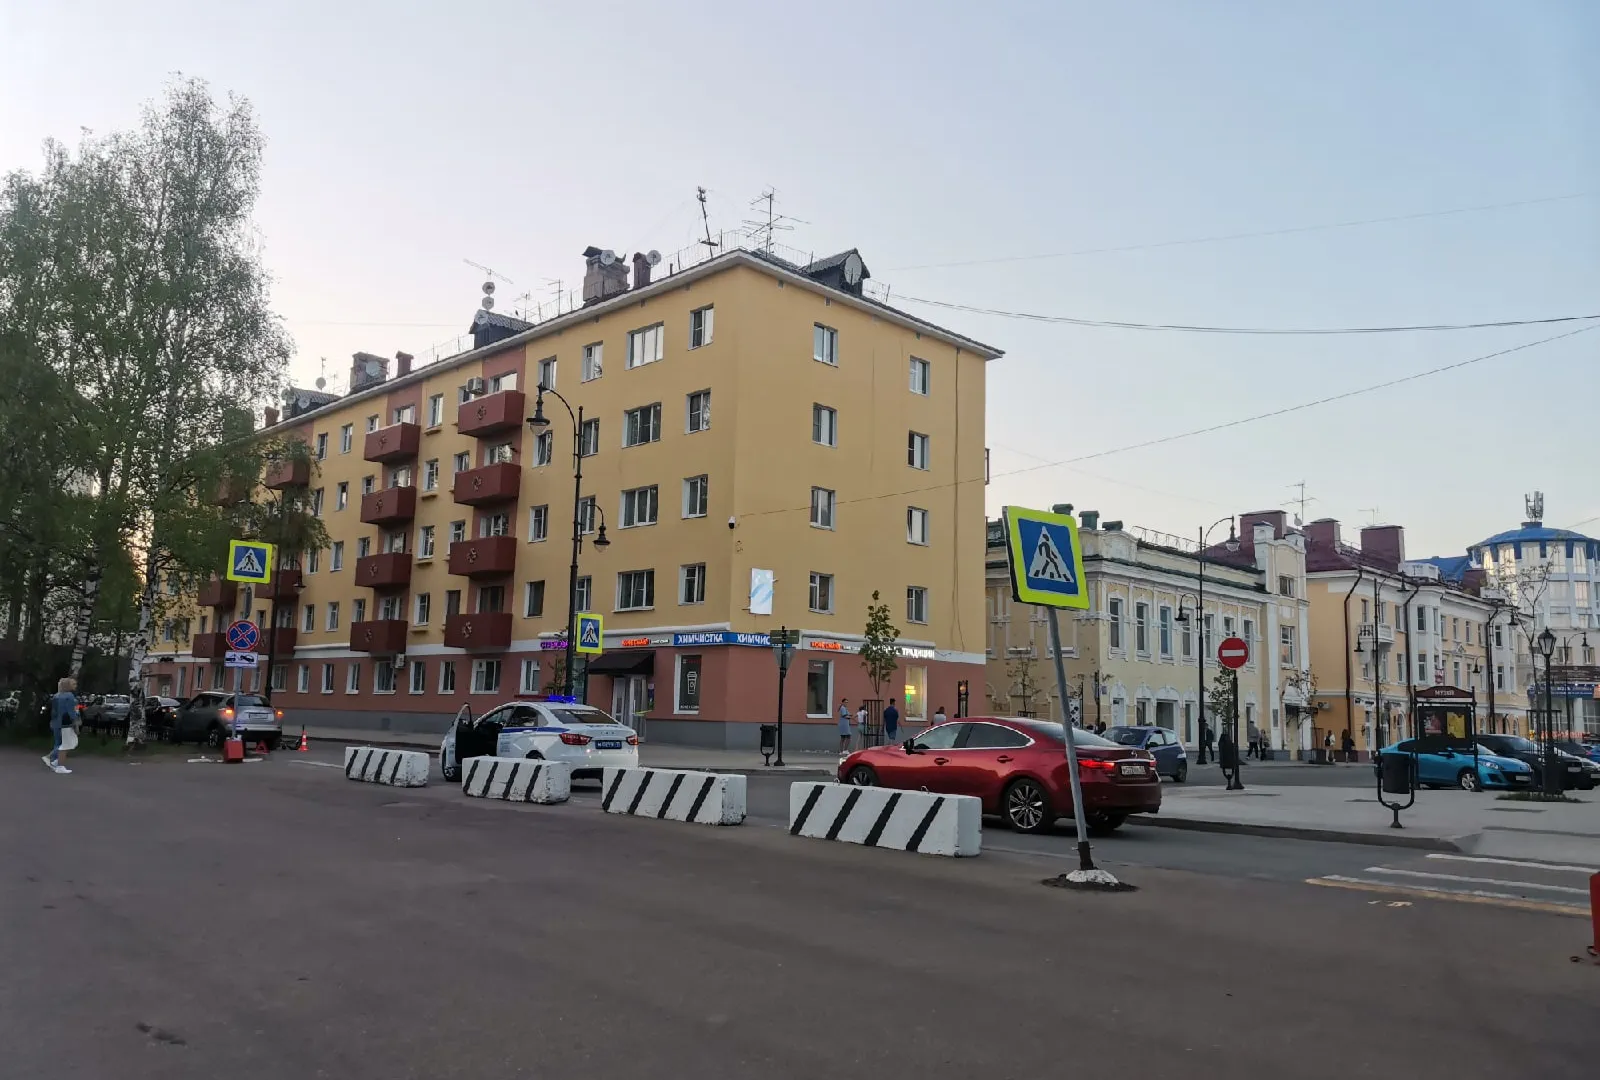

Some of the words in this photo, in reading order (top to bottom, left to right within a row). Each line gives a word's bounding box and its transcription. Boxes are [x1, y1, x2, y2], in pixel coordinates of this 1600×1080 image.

[678, 633, 723, 644] ХИМЧИСТКА
[737, 634, 771, 645] ХИМЧИС
[902, 647, 935, 660] ТРАДИЦИИ
